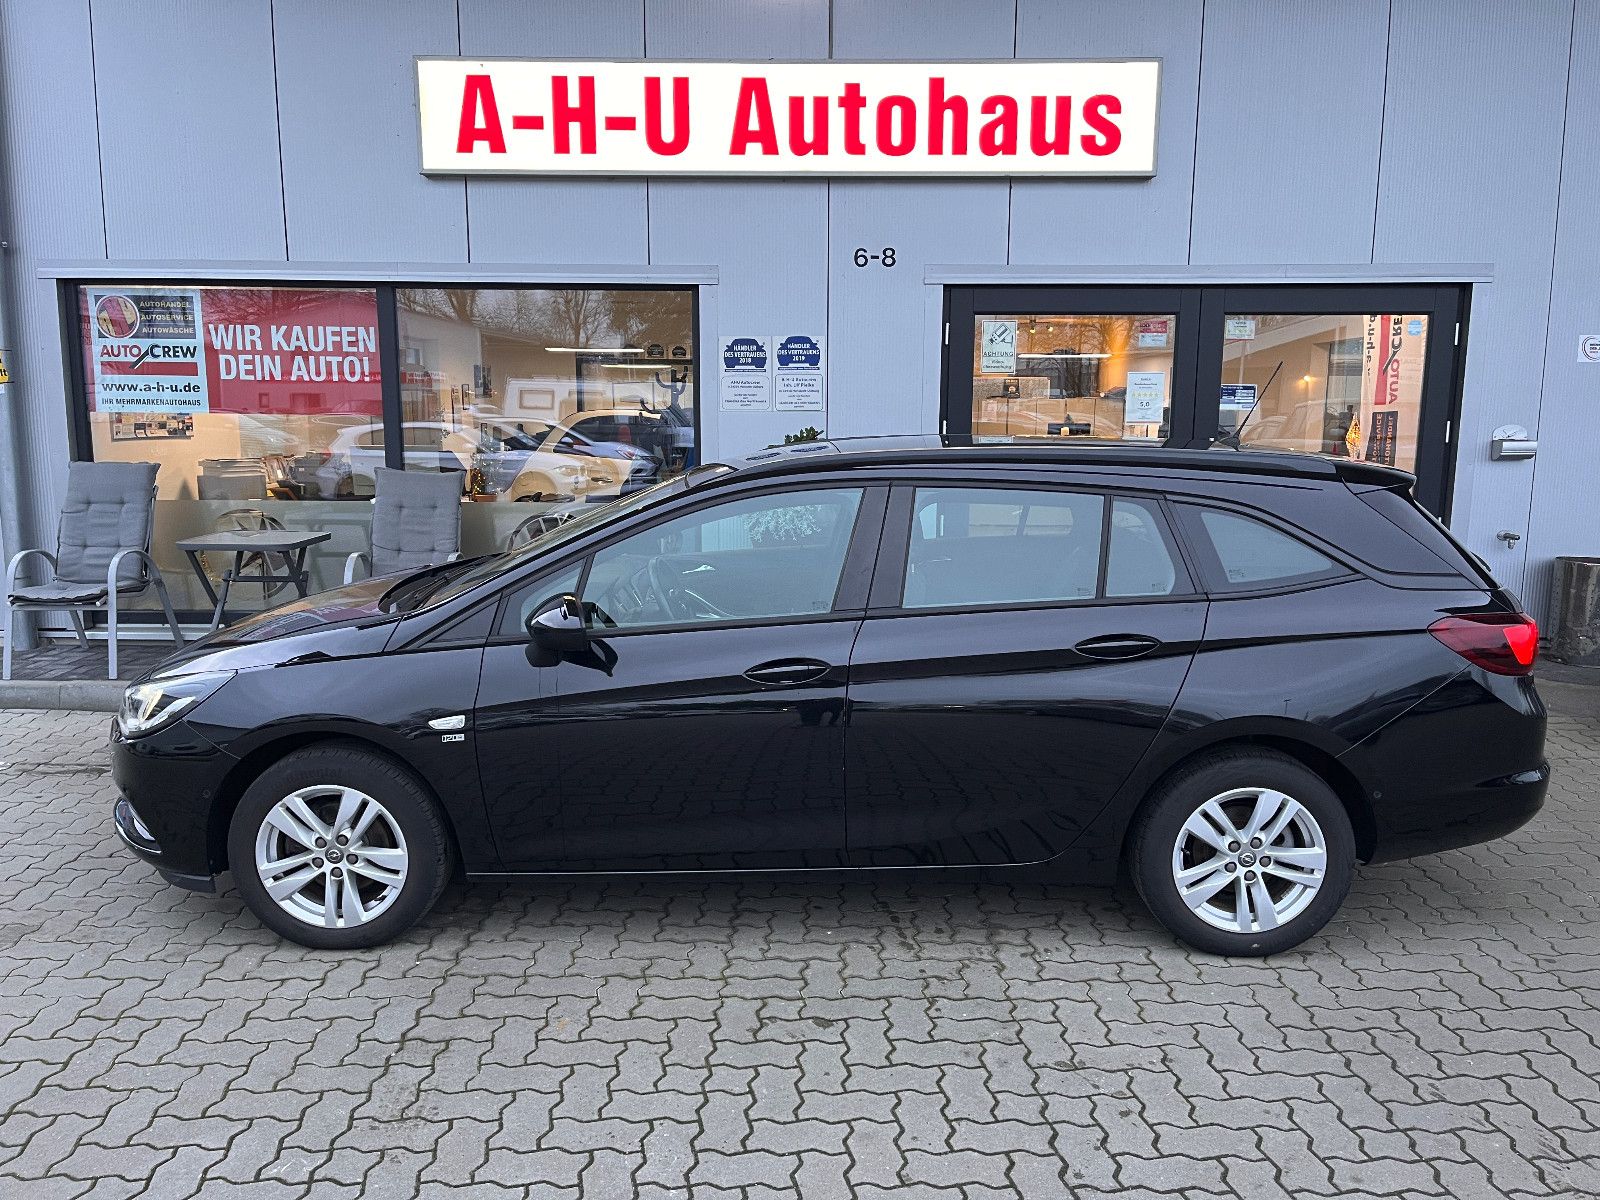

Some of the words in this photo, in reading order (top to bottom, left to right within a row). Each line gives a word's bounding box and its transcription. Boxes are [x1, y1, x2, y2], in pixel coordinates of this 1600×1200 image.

[456, 74, 691, 156] A-H-U
[729, 76, 1123, 157] Autohaus
[853, 247, 897, 268] 6-8
[142, 326, 195, 334] AUTOWÄSCHE
[208, 323, 263, 351] WIR
[270, 325, 376, 353] KAUFEN
[100, 345, 142, 358] AUTO
[149, 343, 197, 359] CREW
[218, 354, 282, 381] DEIN
[290, 355, 370, 382] AUTO!
[101, 381, 201, 393] www.a-h-u.de
[115, 398, 201, 406] MEHRMARKENAUTOHAUS
